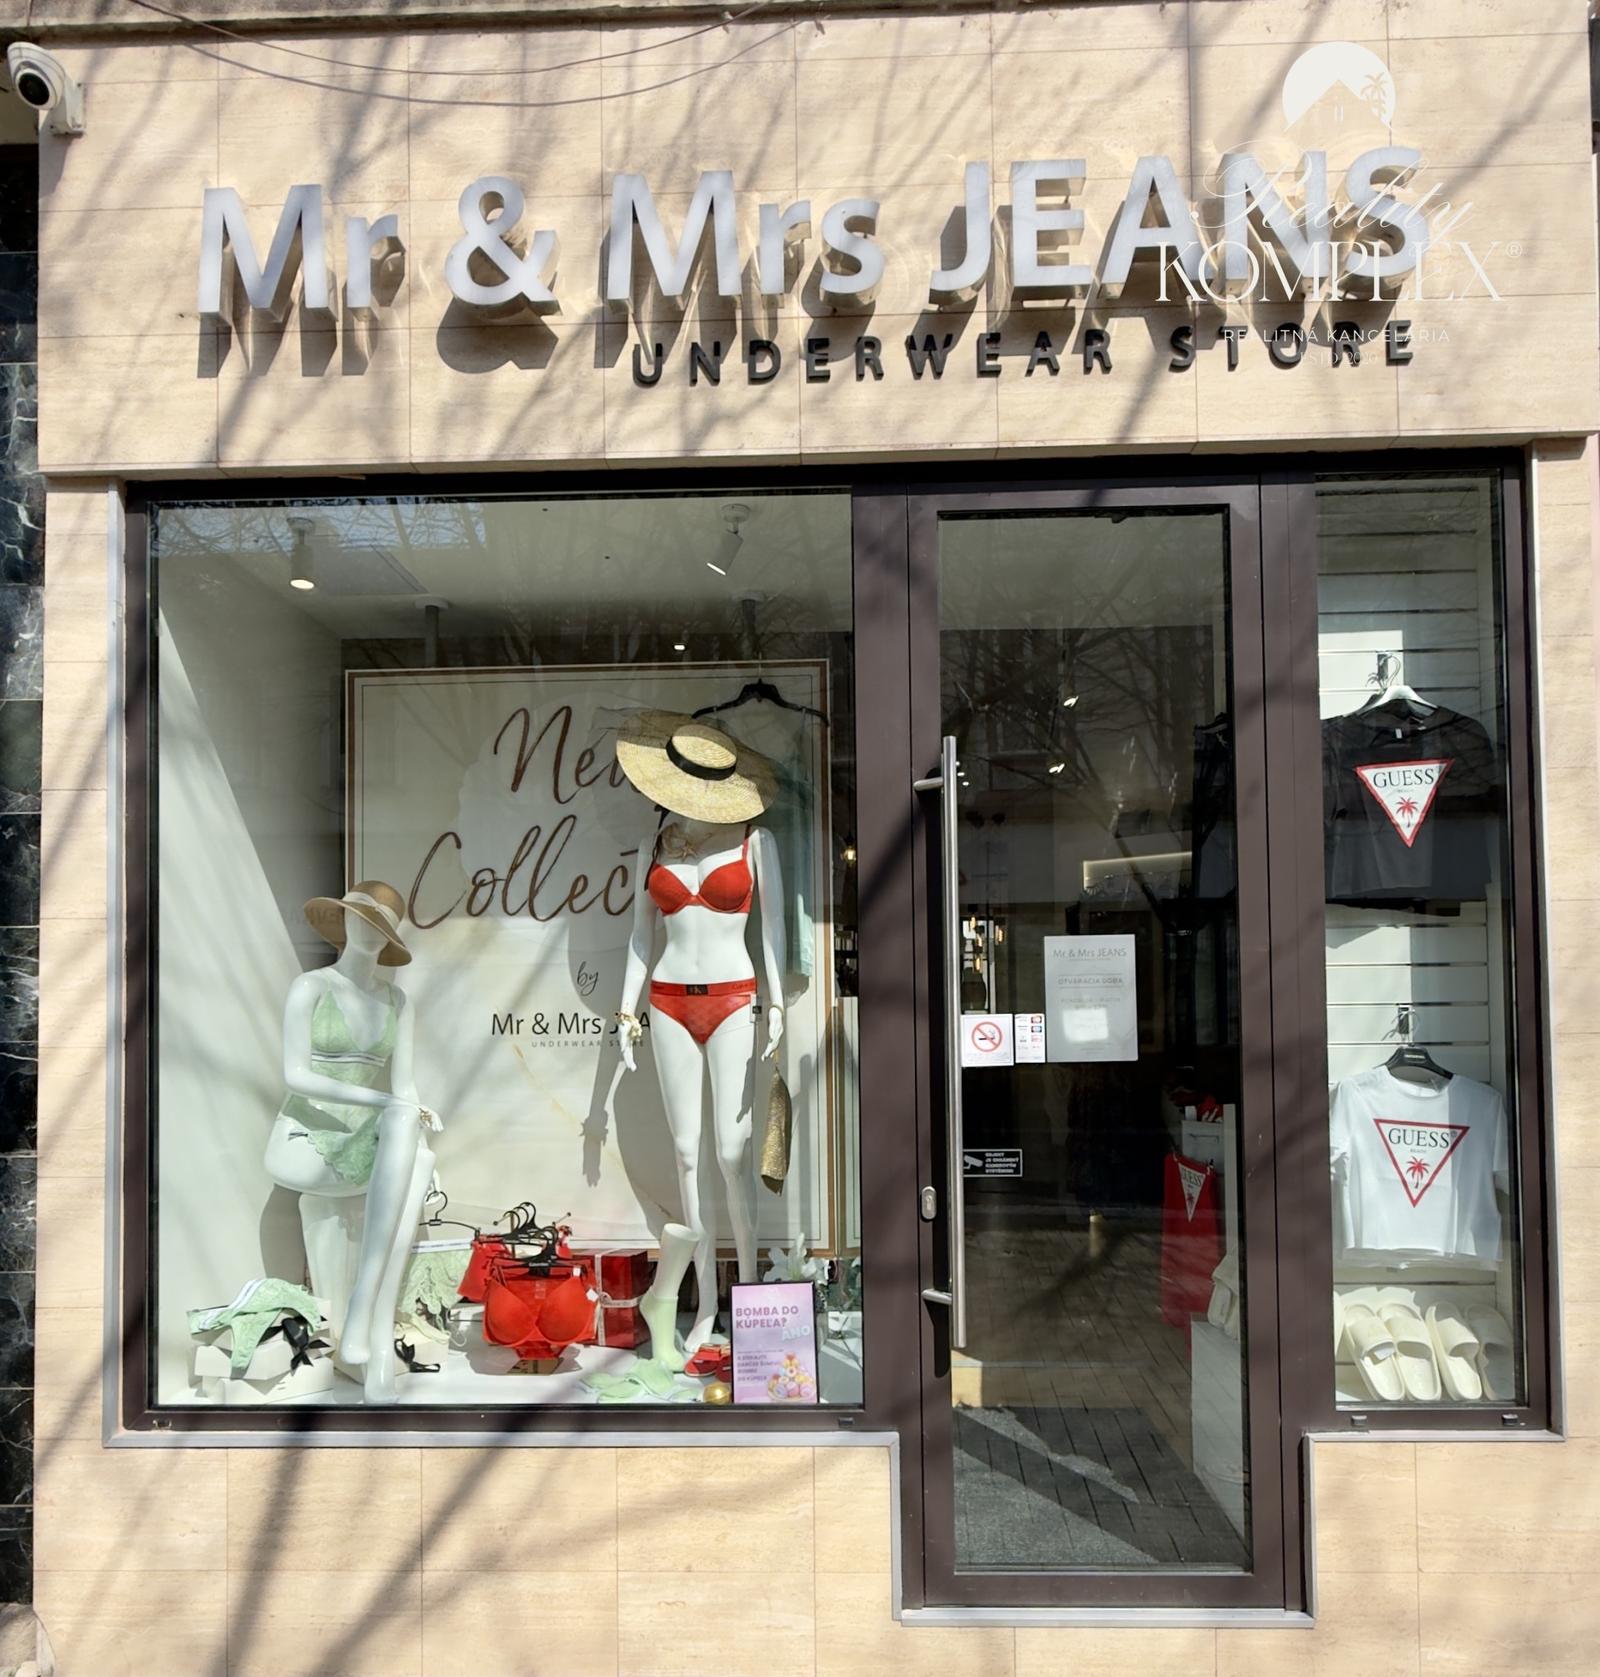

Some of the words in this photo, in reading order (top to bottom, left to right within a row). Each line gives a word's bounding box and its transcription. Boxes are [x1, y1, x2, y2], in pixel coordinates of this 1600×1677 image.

[198, 184, 403, 316] Mr
[445, 176, 558, 309] &
[607, 170, 884, 301] Mrs
[931, 146, 1430, 292] JEANS
[632, 331, 1113, 388] UNDERWEAR
[1169, 320, 1414, 374] STORE
[1373, 768, 1434, 789] GUESS
[408, 814, 638, 929] Collec
[1097, 947, 1127, 957] JEANS
[577, 960, 599, 996] by
[491, 1012, 524, 1036] Mr
[532, 1012, 550, 1035] &
[558, 1012, 602, 1035] Mrs
[1388, 1128, 1450, 1149] GUESS
[736, 1306, 780, 1317] BOMBA
[782, 1305, 799, 1316] DO
